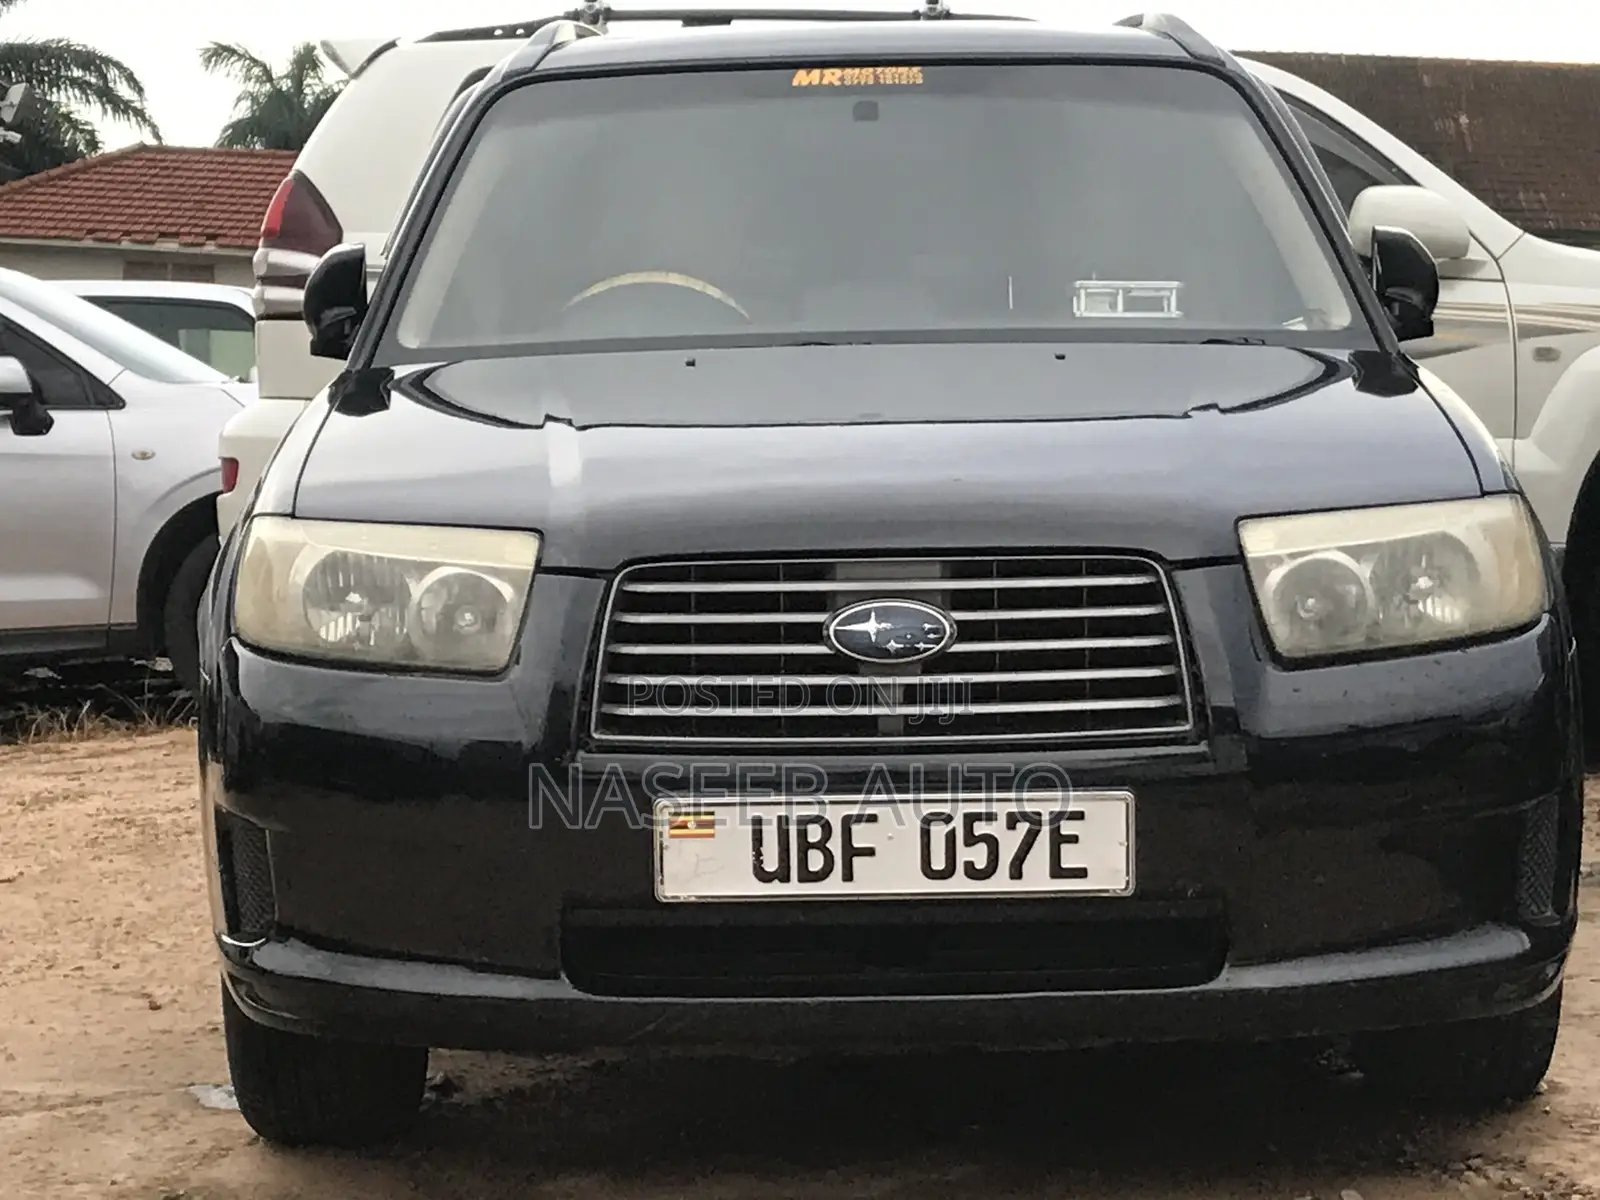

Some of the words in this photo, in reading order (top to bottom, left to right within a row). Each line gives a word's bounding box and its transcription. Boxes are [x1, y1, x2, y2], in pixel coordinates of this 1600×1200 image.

[792, 68, 842, 86] MR
[752, 813, 879, 883] UBF
[920, 810, 1088, 881] 057E
